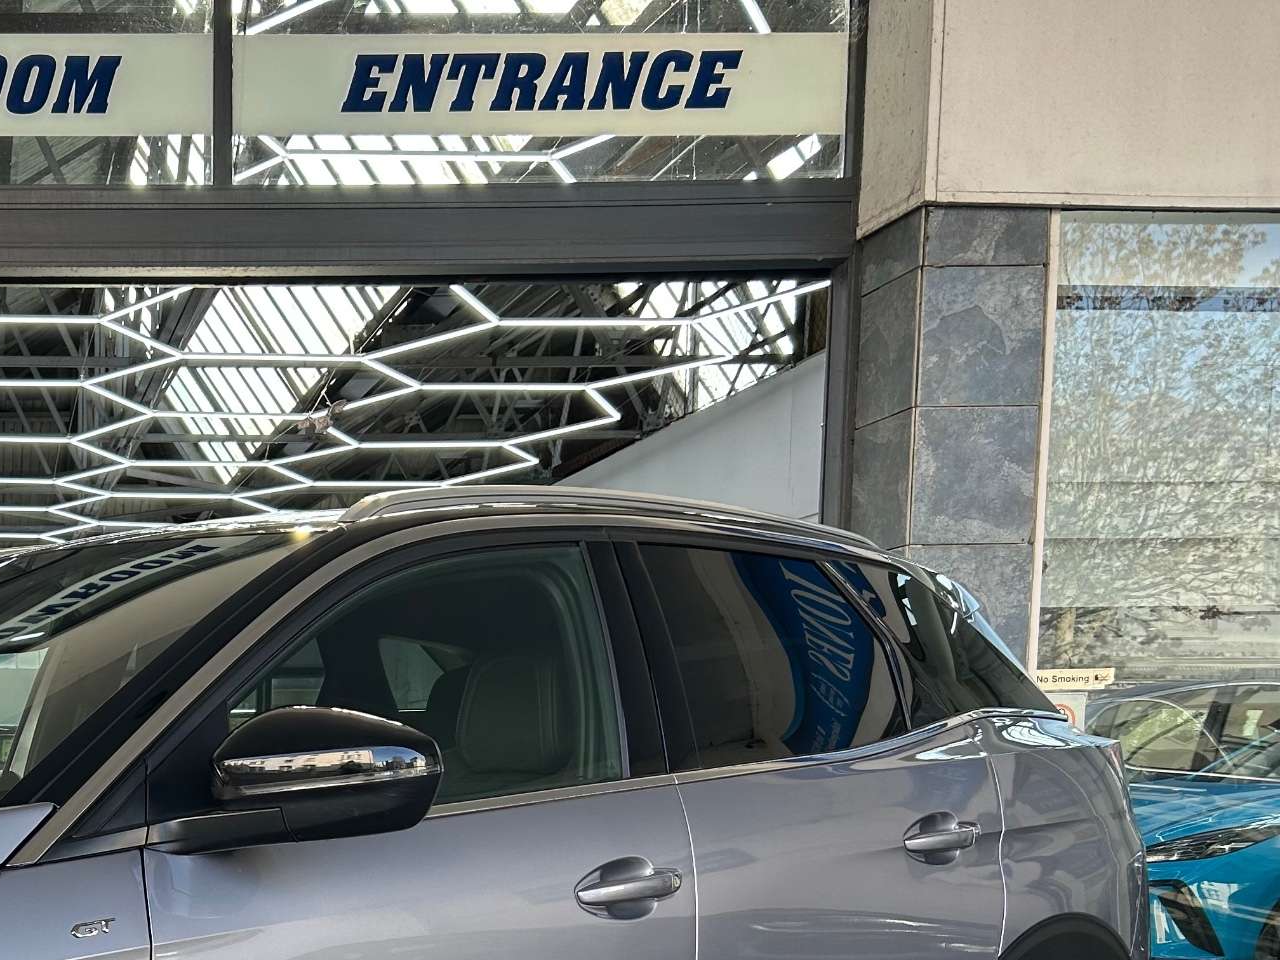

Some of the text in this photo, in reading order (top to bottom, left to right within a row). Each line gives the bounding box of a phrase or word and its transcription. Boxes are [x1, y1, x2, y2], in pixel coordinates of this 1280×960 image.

[340, 49, 744, 112] ENTRANCE
[1036, 674, 1090, 684] No Smoking
[71, 918, 116, 938] GT
